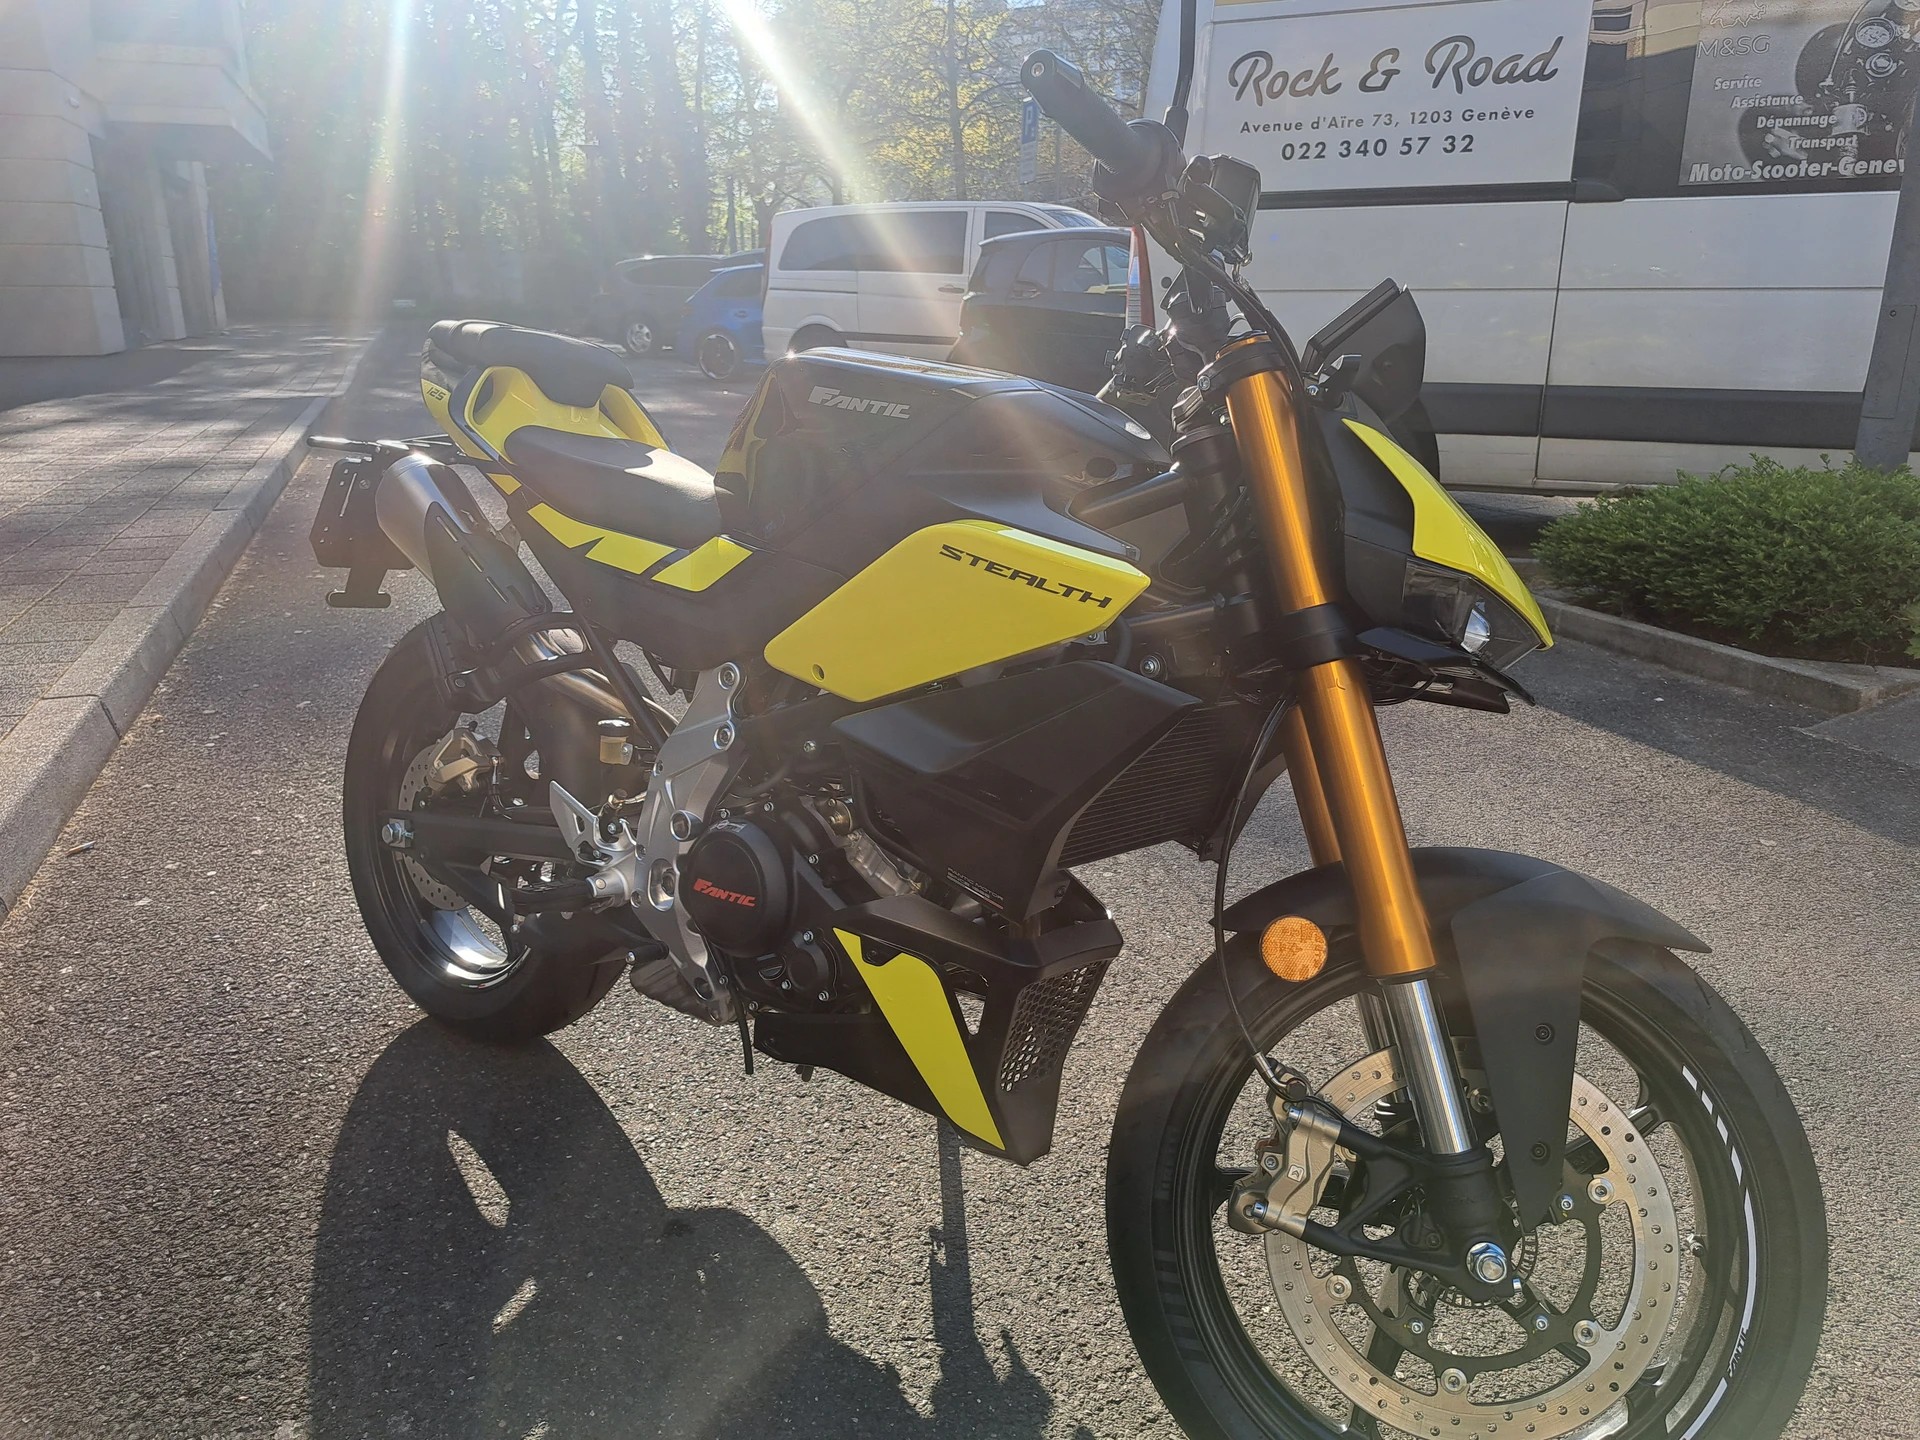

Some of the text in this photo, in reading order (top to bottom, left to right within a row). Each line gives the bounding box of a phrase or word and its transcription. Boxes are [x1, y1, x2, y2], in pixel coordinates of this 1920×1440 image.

[1697, 35, 1771, 58] M&SG
[1227, 35, 1564, 106] Rock & Road
[1714, 75, 1762, 91] Service
[1731, 94, 1804, 109] Assistance
[1240, 106, 1535, 134] Avenue d'Aïre 73, 1203 Genève
[1756, 114, 1838, 129] Dépannage
[1281, 134, 1475, 161] 022 340 57 32
[1788, 134, 1858, 150] Transport
[427, 387, 446, 401] 125
[808, 385, 910, 419] FANTIC
[939, 543, 1113, 609] STEALTH
[693, 878, 756, 907] FANTIC
